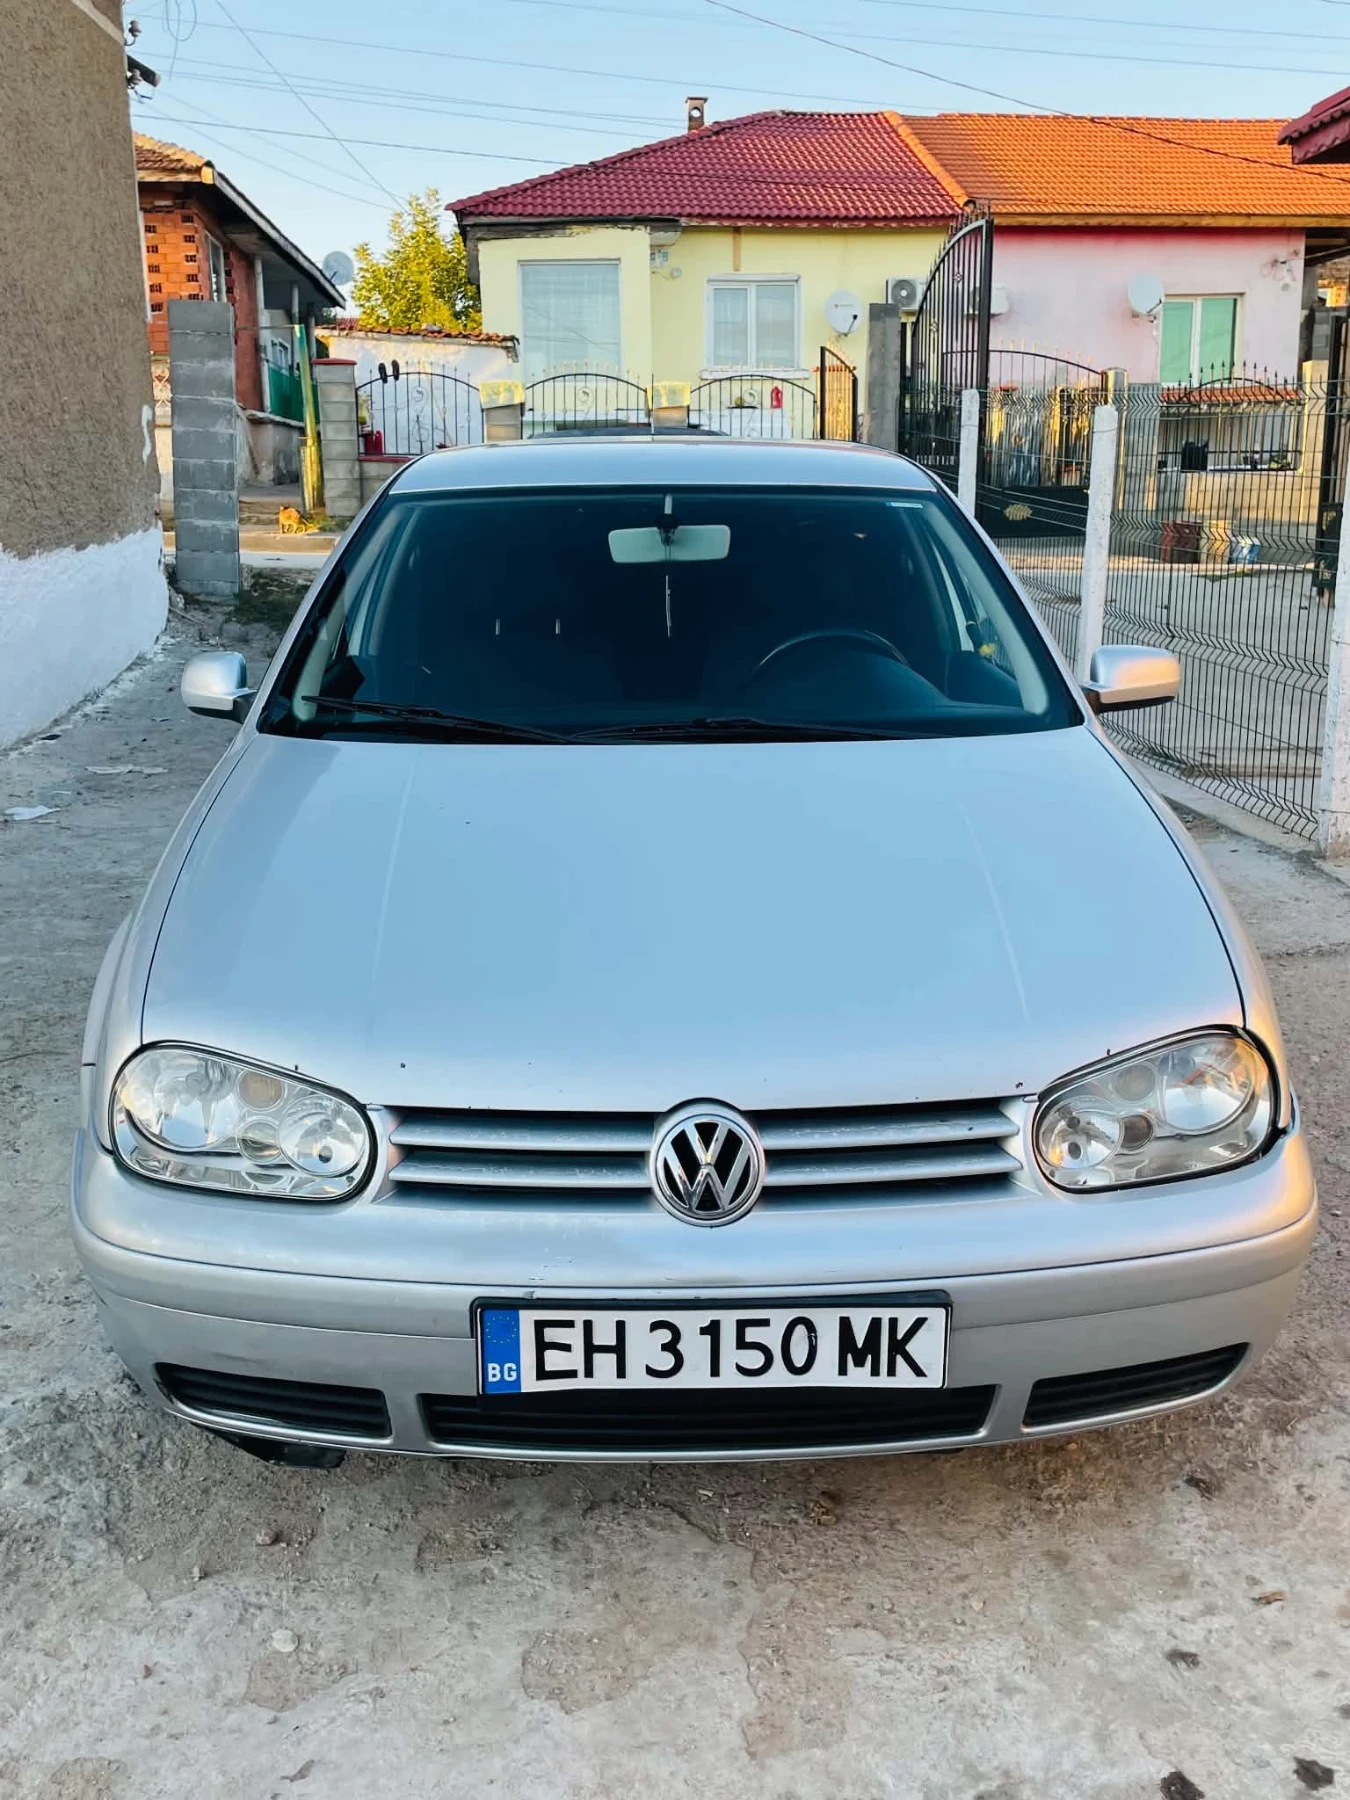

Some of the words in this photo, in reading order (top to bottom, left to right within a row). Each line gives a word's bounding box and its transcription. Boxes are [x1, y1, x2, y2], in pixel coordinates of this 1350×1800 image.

[658, 1115, 758, 1219] VW
[487, 1362, 517, 1382] BG
[534, 1319, 627, 1380] EH
[645, 1316, 818, 1379] 3150
[838, 1316, 929, 1377] MK
